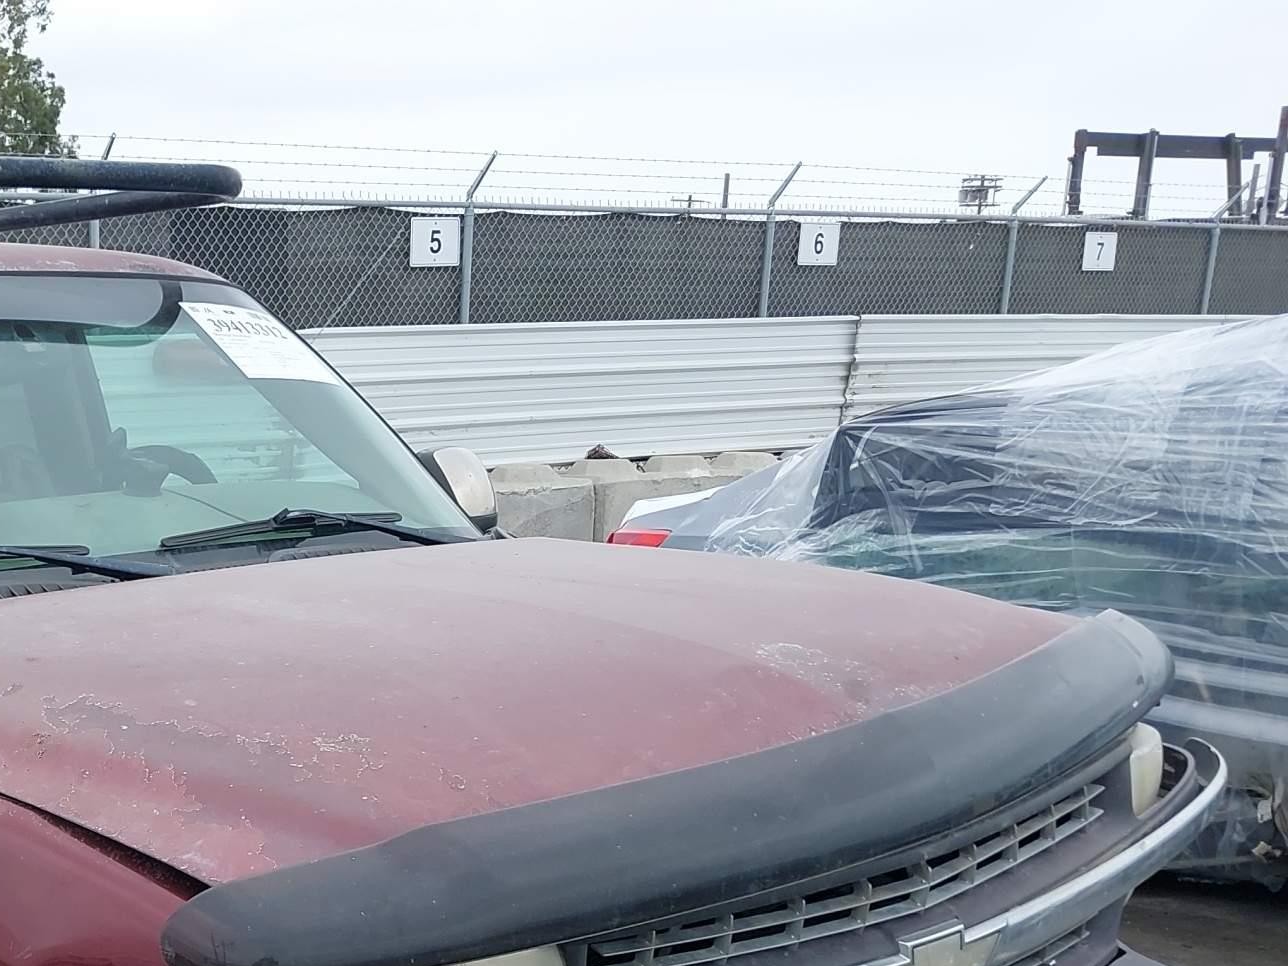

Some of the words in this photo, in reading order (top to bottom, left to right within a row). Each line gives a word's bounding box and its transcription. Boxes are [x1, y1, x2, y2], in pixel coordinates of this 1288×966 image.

[429, 229, 442, 254] 5
[814, 232, 825, 255] 6
[1097, 242, 1105, 261] 7
[206, 318, 289, 340] 39413312
